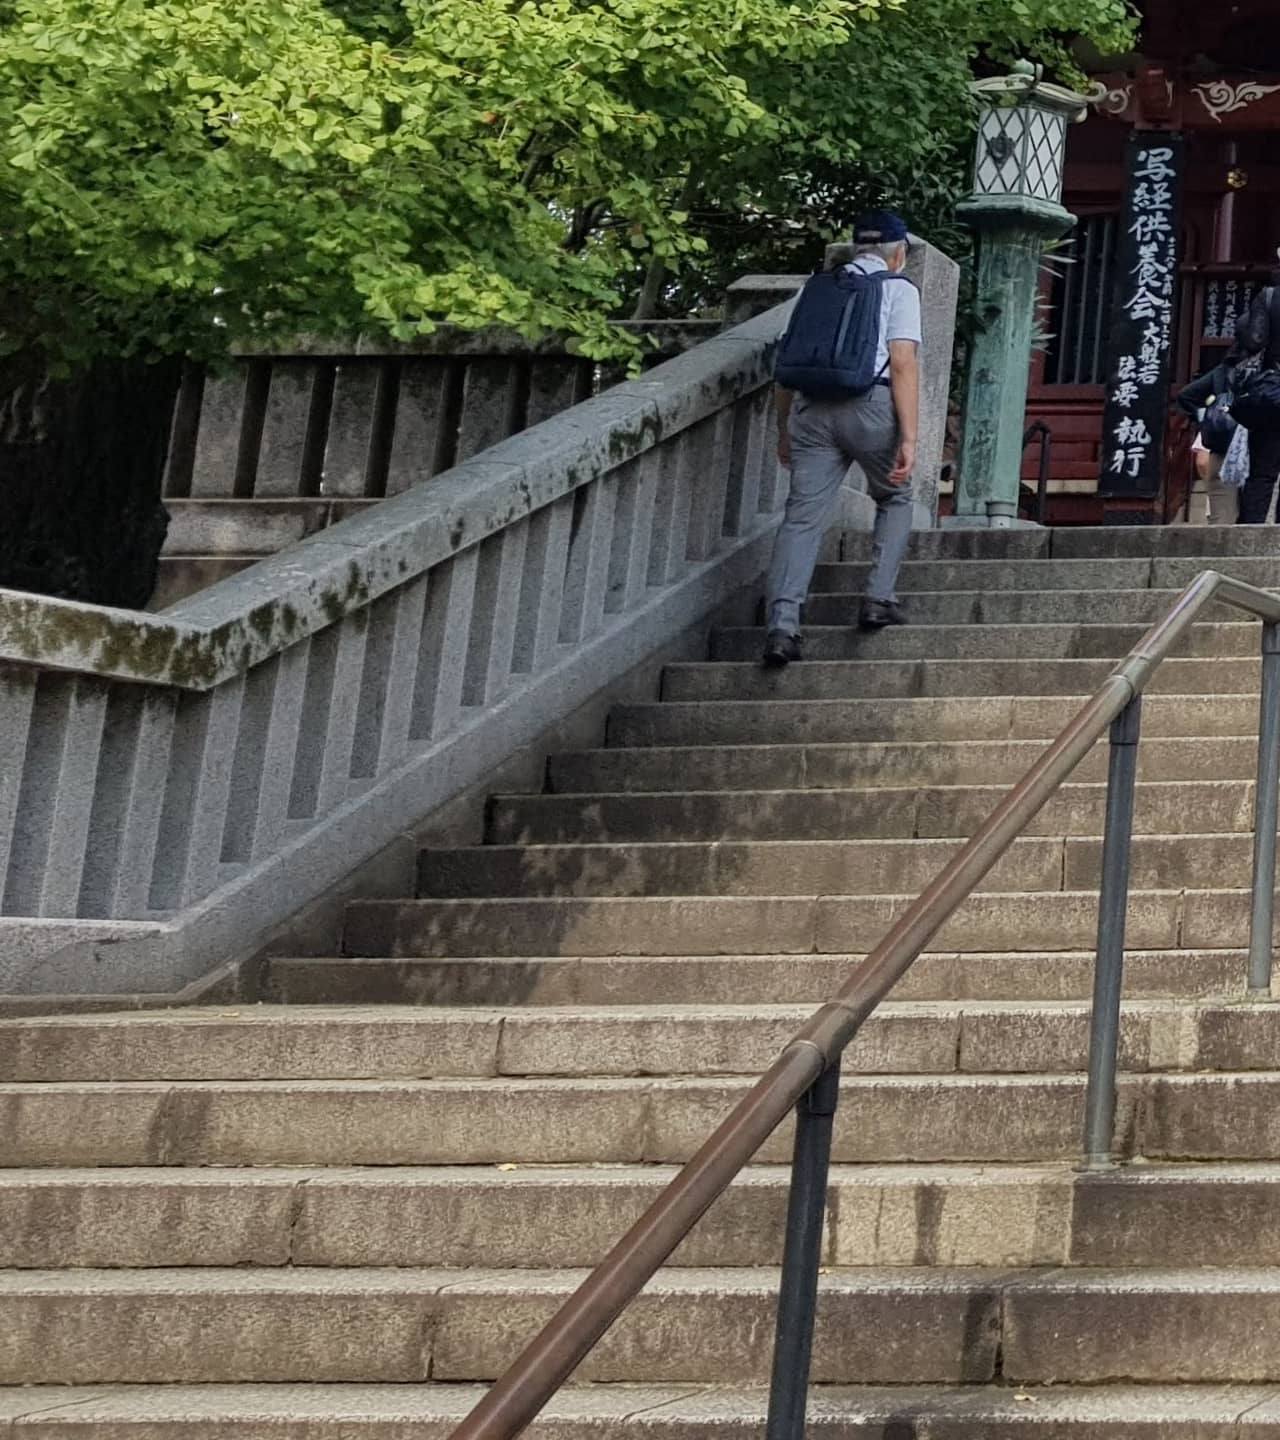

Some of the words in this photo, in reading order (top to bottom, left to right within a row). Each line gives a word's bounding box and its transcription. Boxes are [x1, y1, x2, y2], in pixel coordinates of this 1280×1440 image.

[1122, 146, 1177, 321] 写経供養会
[1136, 322, 1162, 385] 大般若
